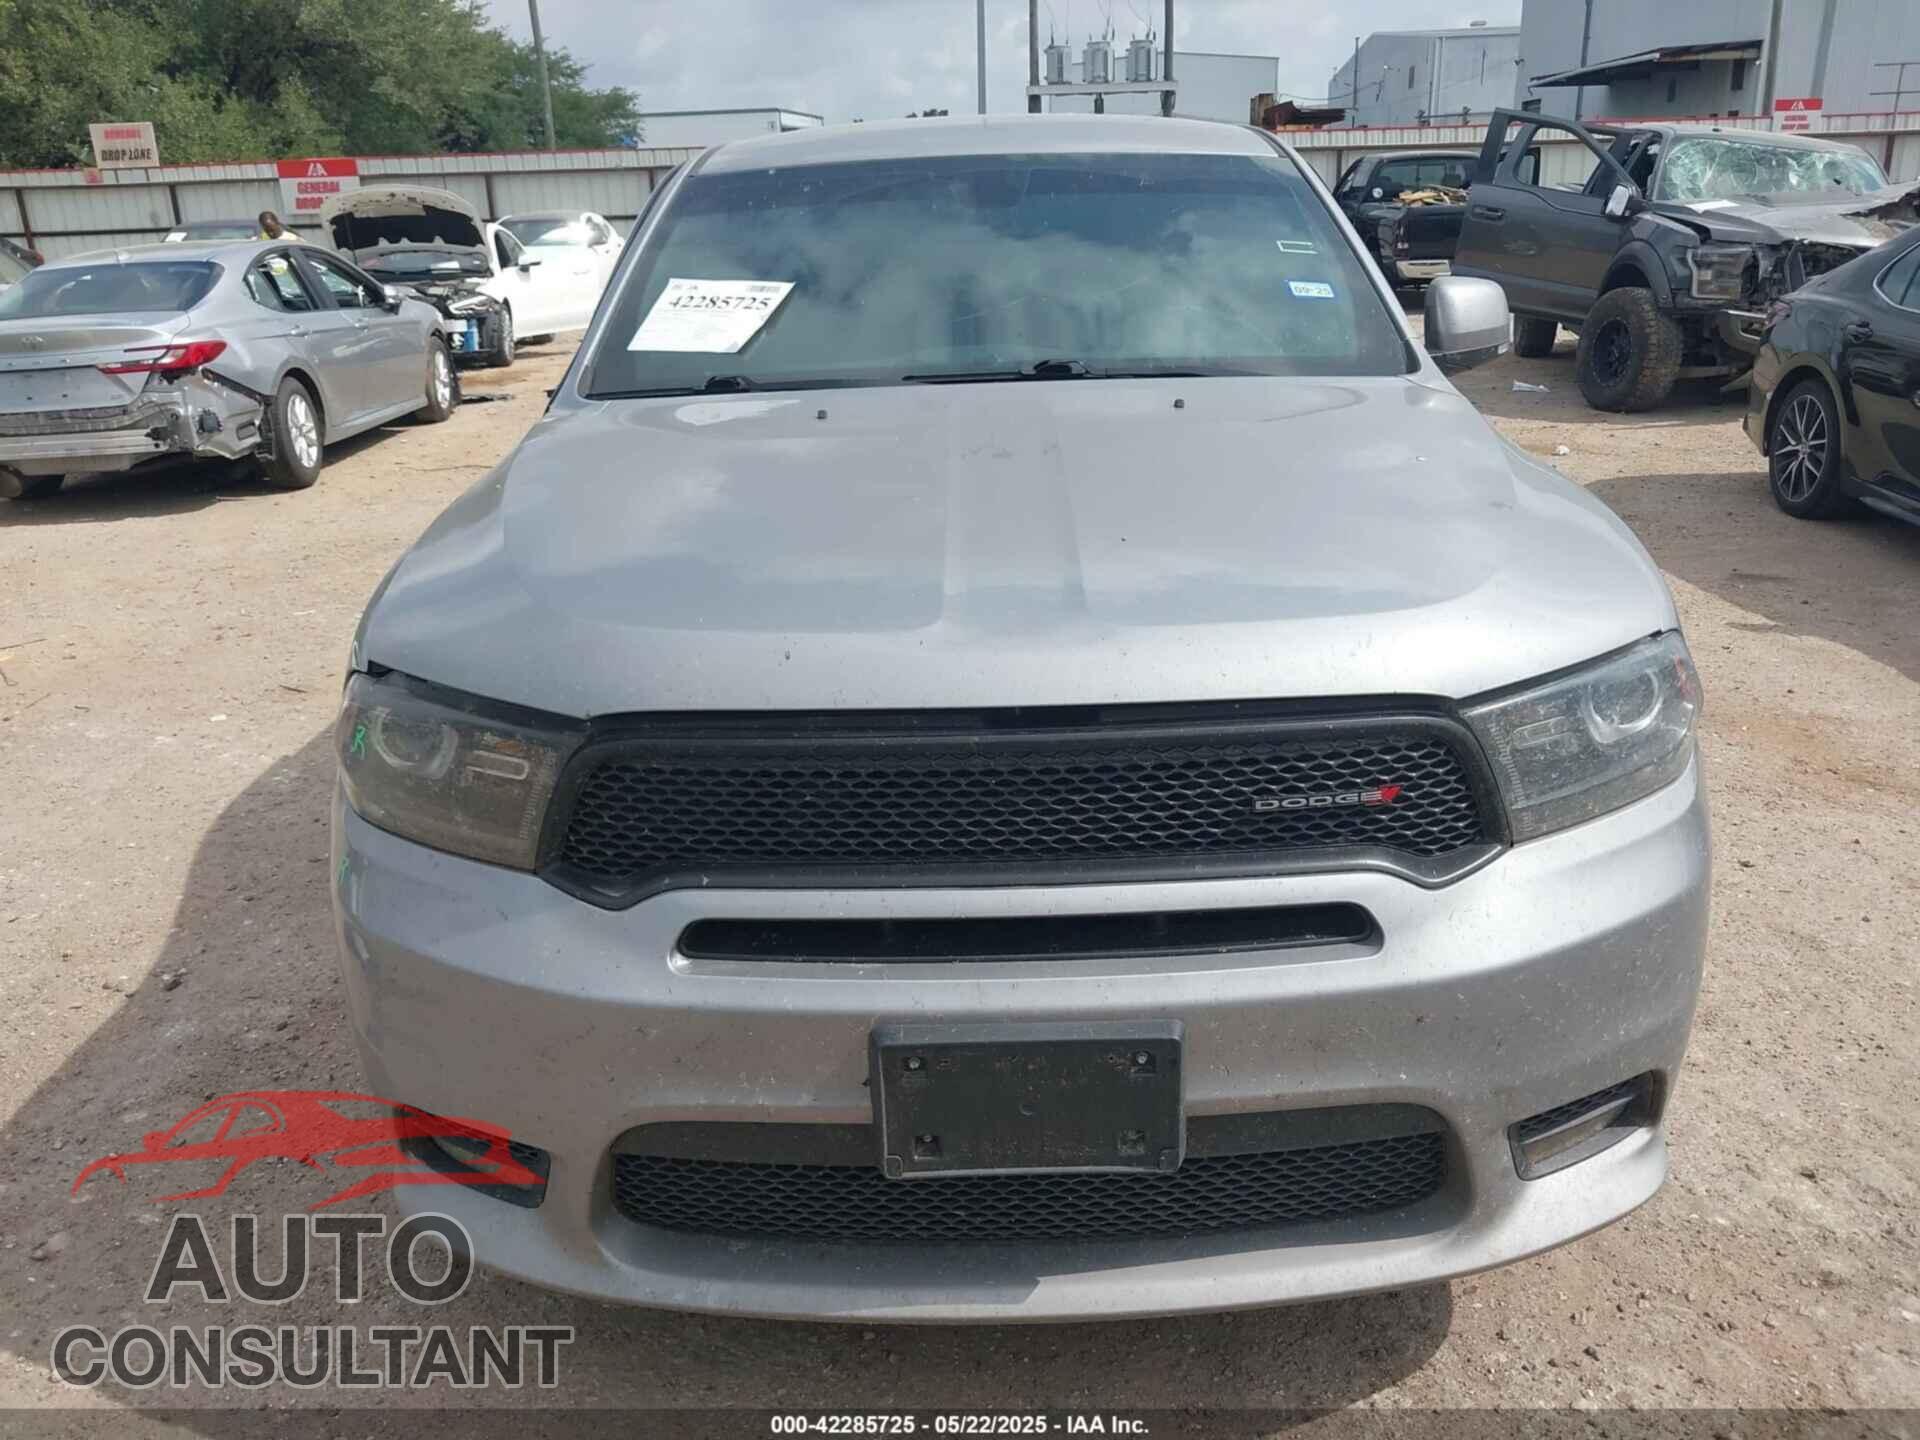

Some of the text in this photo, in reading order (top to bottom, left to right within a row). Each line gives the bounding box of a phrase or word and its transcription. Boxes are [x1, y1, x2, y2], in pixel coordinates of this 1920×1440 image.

[101, 149, 127, 161] DROP
[669, 295, 772, 311] 42285725
[1255, 790, 1388, 810] DODGE
